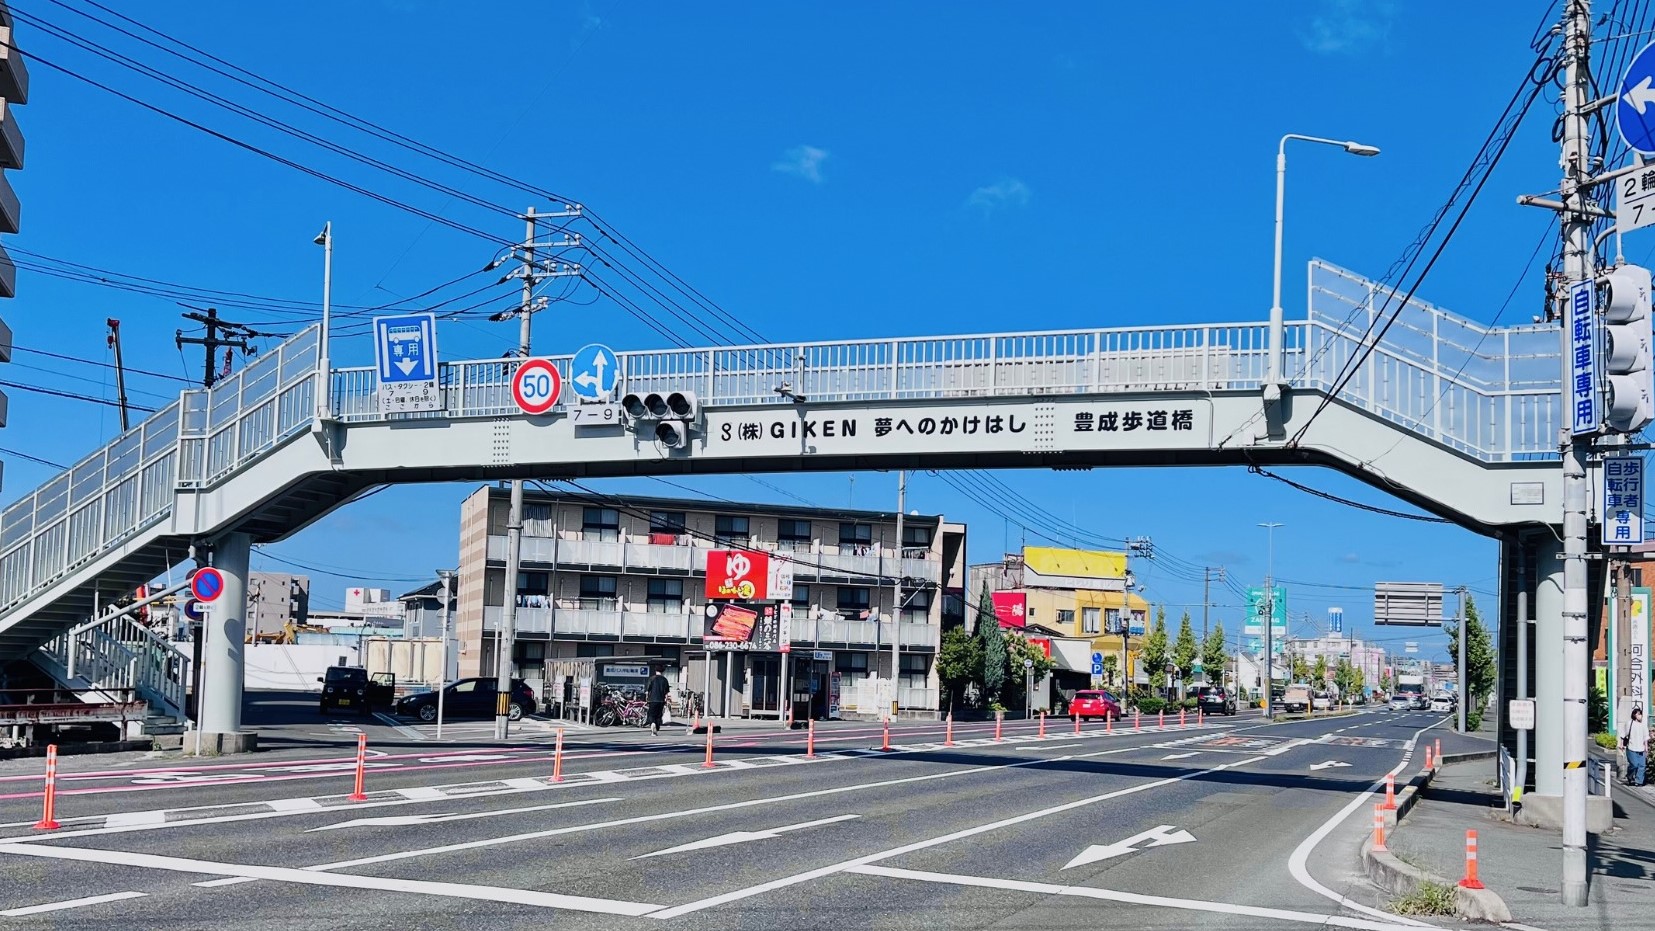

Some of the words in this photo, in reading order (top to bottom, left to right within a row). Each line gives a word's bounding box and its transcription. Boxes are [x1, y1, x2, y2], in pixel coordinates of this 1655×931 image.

[393, 343, 419, 357] 専用
[1574, 288, 1593, 427] 自転車専用
[523, 374, 549, 398] 50
[738, 422, 763, 440] (株)
[770, 419, 857, 438] GIKEN
[874, 414, 1027, 437] 夢へのかけはし
[1073, 409, 1194, 432] 豊成歩道橋
[726, 553, 751, 581] ゆ
[1094, 664, 1101, 674] P
